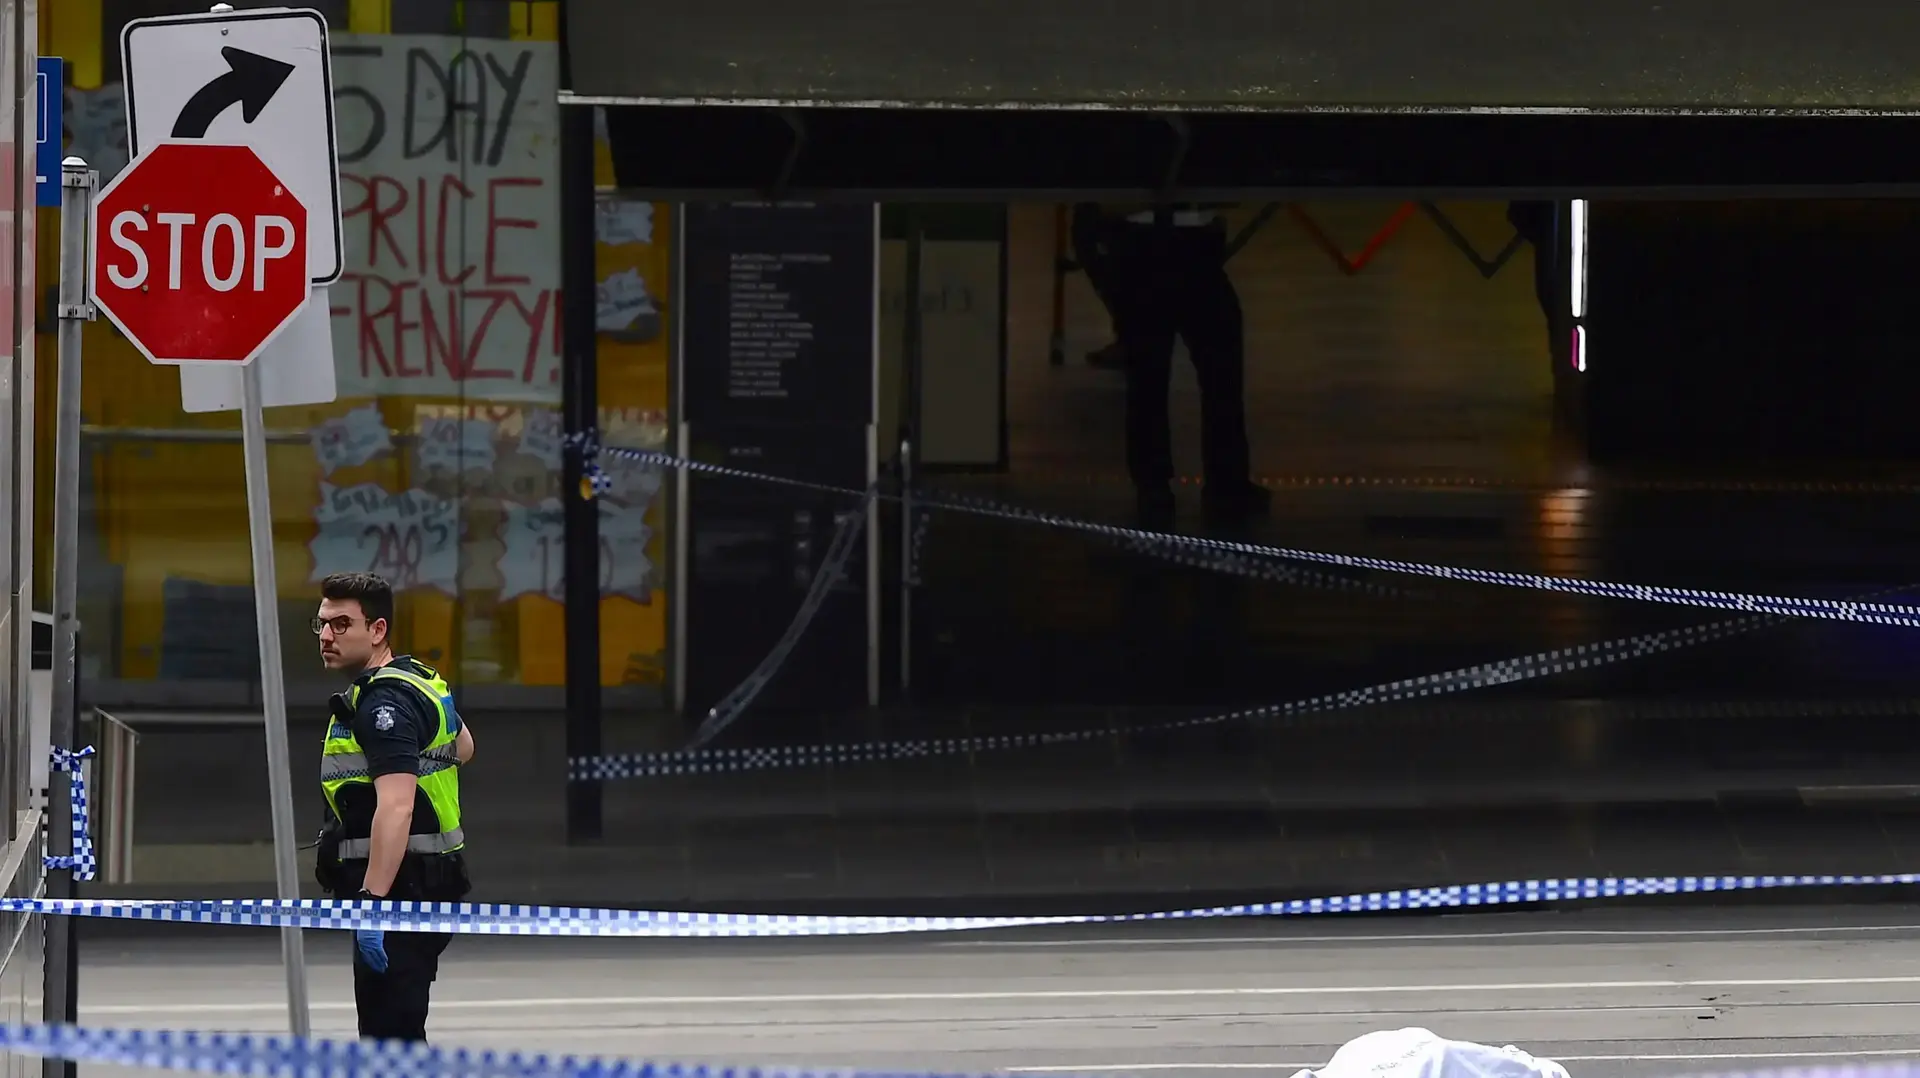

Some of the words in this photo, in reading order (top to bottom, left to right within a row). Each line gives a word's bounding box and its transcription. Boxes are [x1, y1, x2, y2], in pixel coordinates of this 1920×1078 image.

[331, 46, 386, 164] 5
[404, 48, 533, 167] DAY
[107, 210, 296, 292] STOP
[341, 173, 544, 286] PRICE
